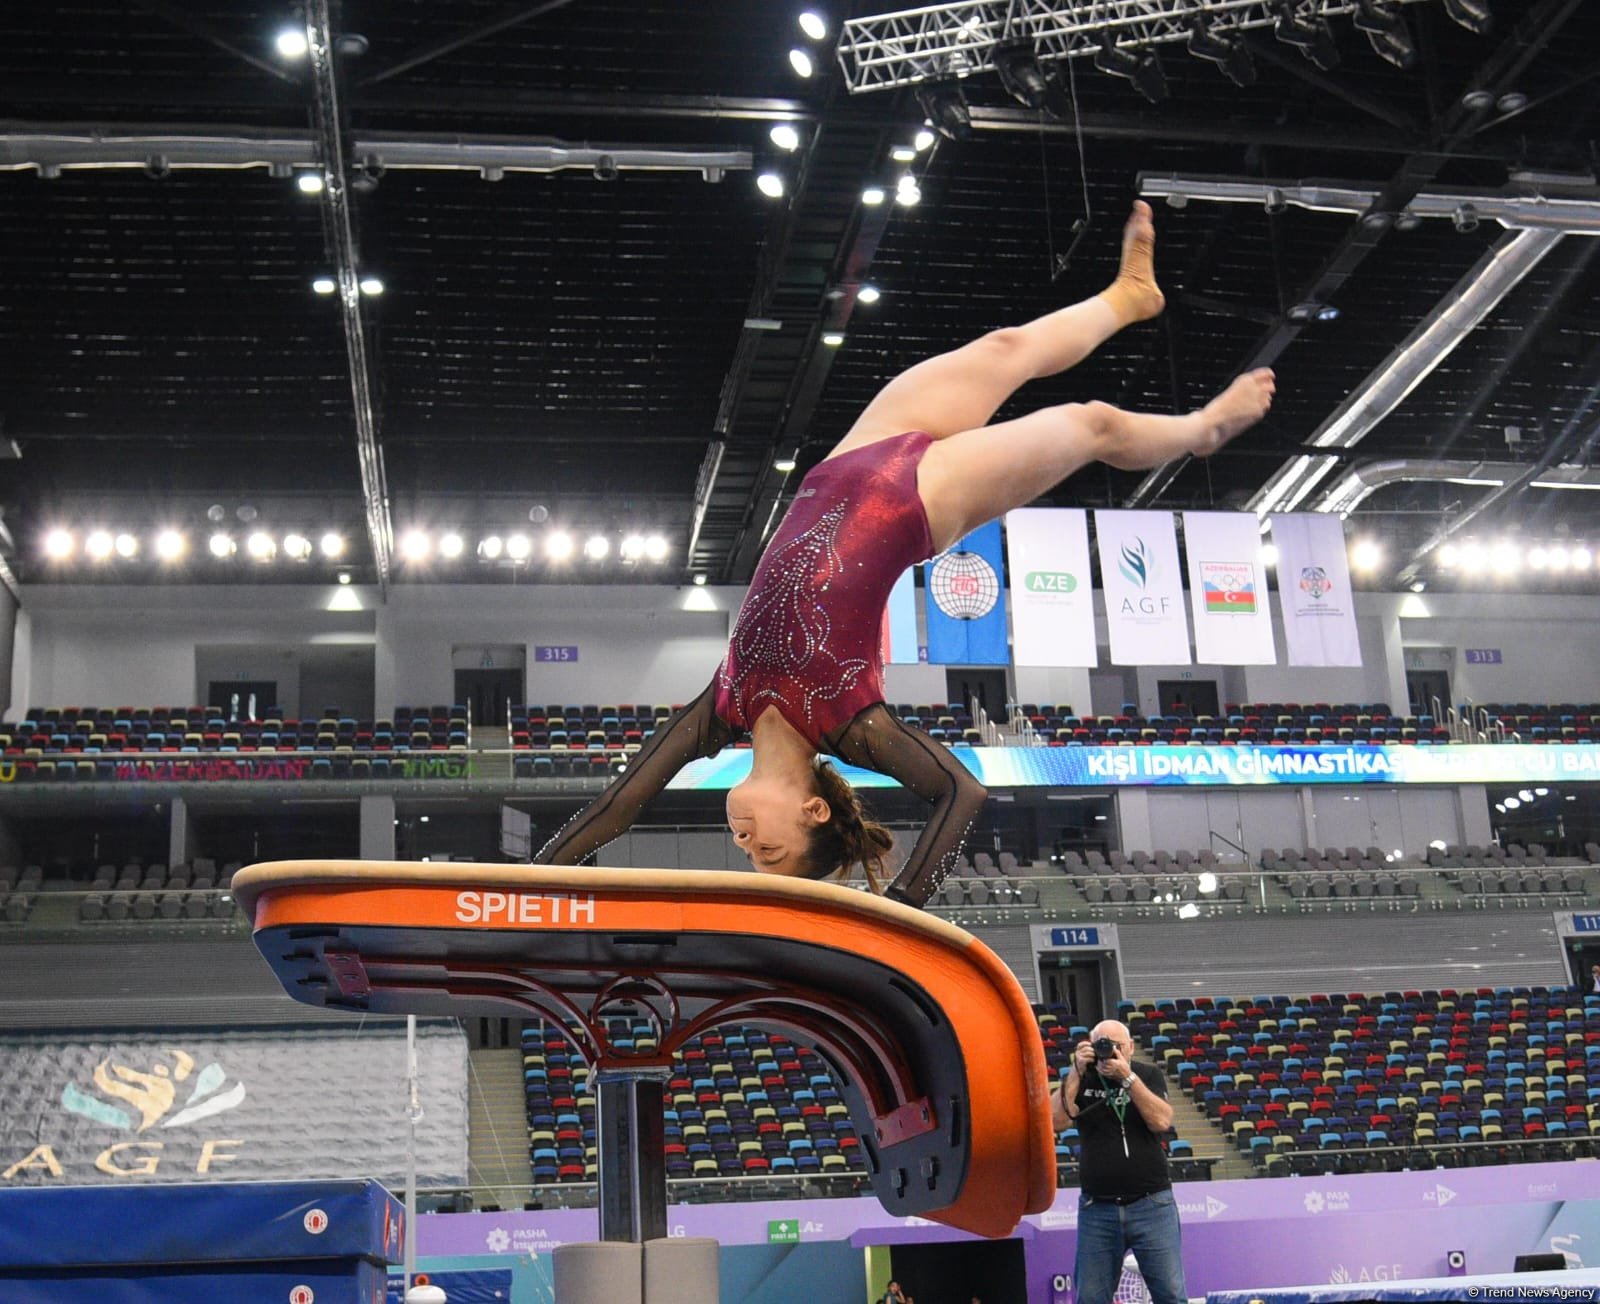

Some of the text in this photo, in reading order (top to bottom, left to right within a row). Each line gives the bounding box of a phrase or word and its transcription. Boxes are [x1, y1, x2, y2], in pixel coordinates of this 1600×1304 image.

[1033, 575, 1068, 590] AZE
[1121, 597, 1171, 614] AGF
[543, 648, 570, 660] 315
[1473, 650, 1494, 662] 313
[1087, 749, 1137, 781] KİŞİ
[1144, 749, 1230, 776] İDMAN
[455, 891, 595, 923] SPIETH
[1582, 916, 1600, 929] 11
[1061, 930, 1088, 943] 114
[2, 1139, 245, 1179] AGF
[513, 1229, 548, 1238] PASHA
